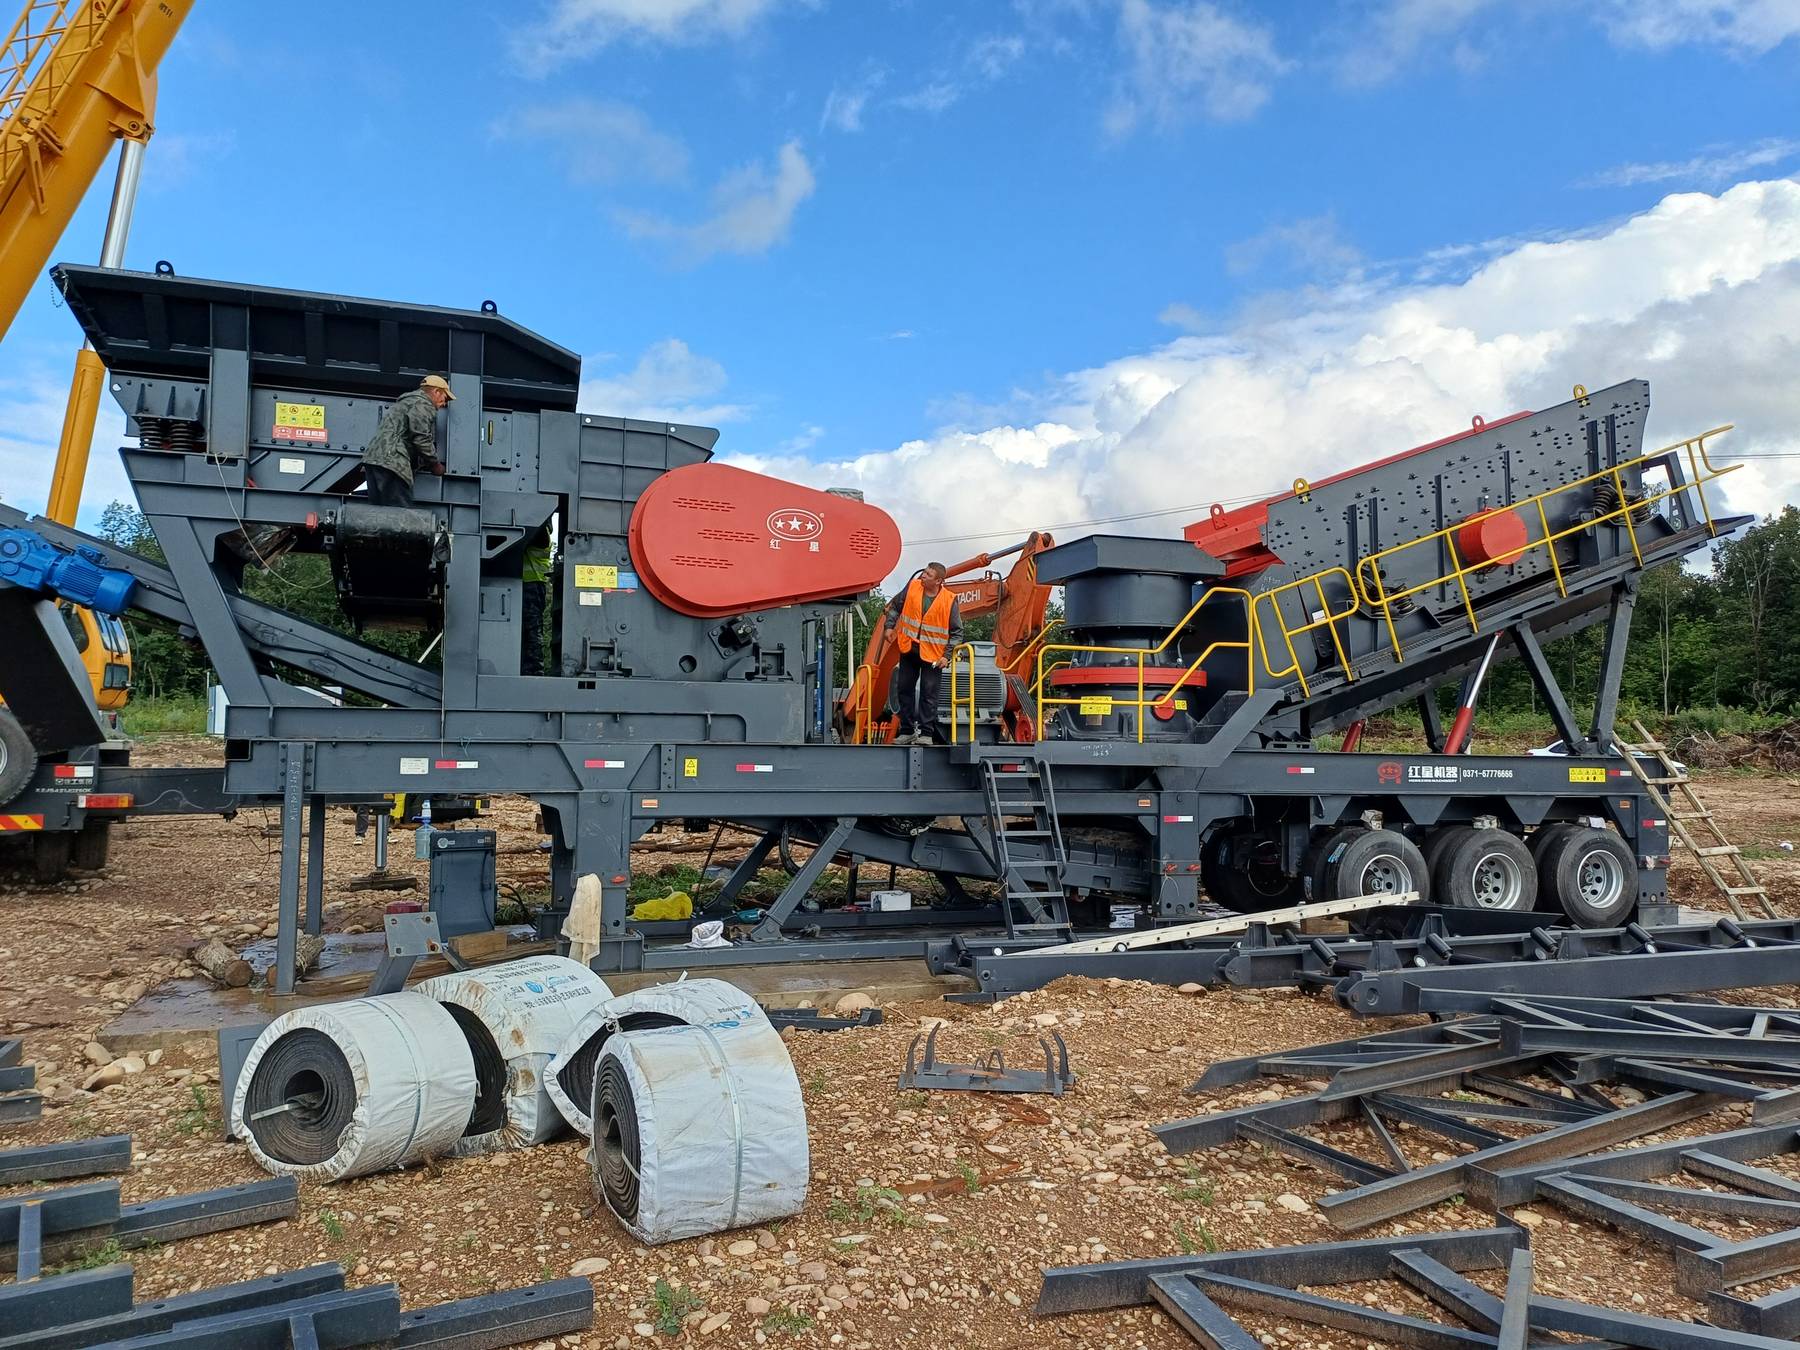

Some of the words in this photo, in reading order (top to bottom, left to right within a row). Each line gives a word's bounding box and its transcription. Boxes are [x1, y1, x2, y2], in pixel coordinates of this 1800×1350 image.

[769, 538, 781, 550] 红
[809, 541, 820, 552] 星
[957, 588, 981, 604] TACHI
[1408, 765, 1458, 778] 红星机器
